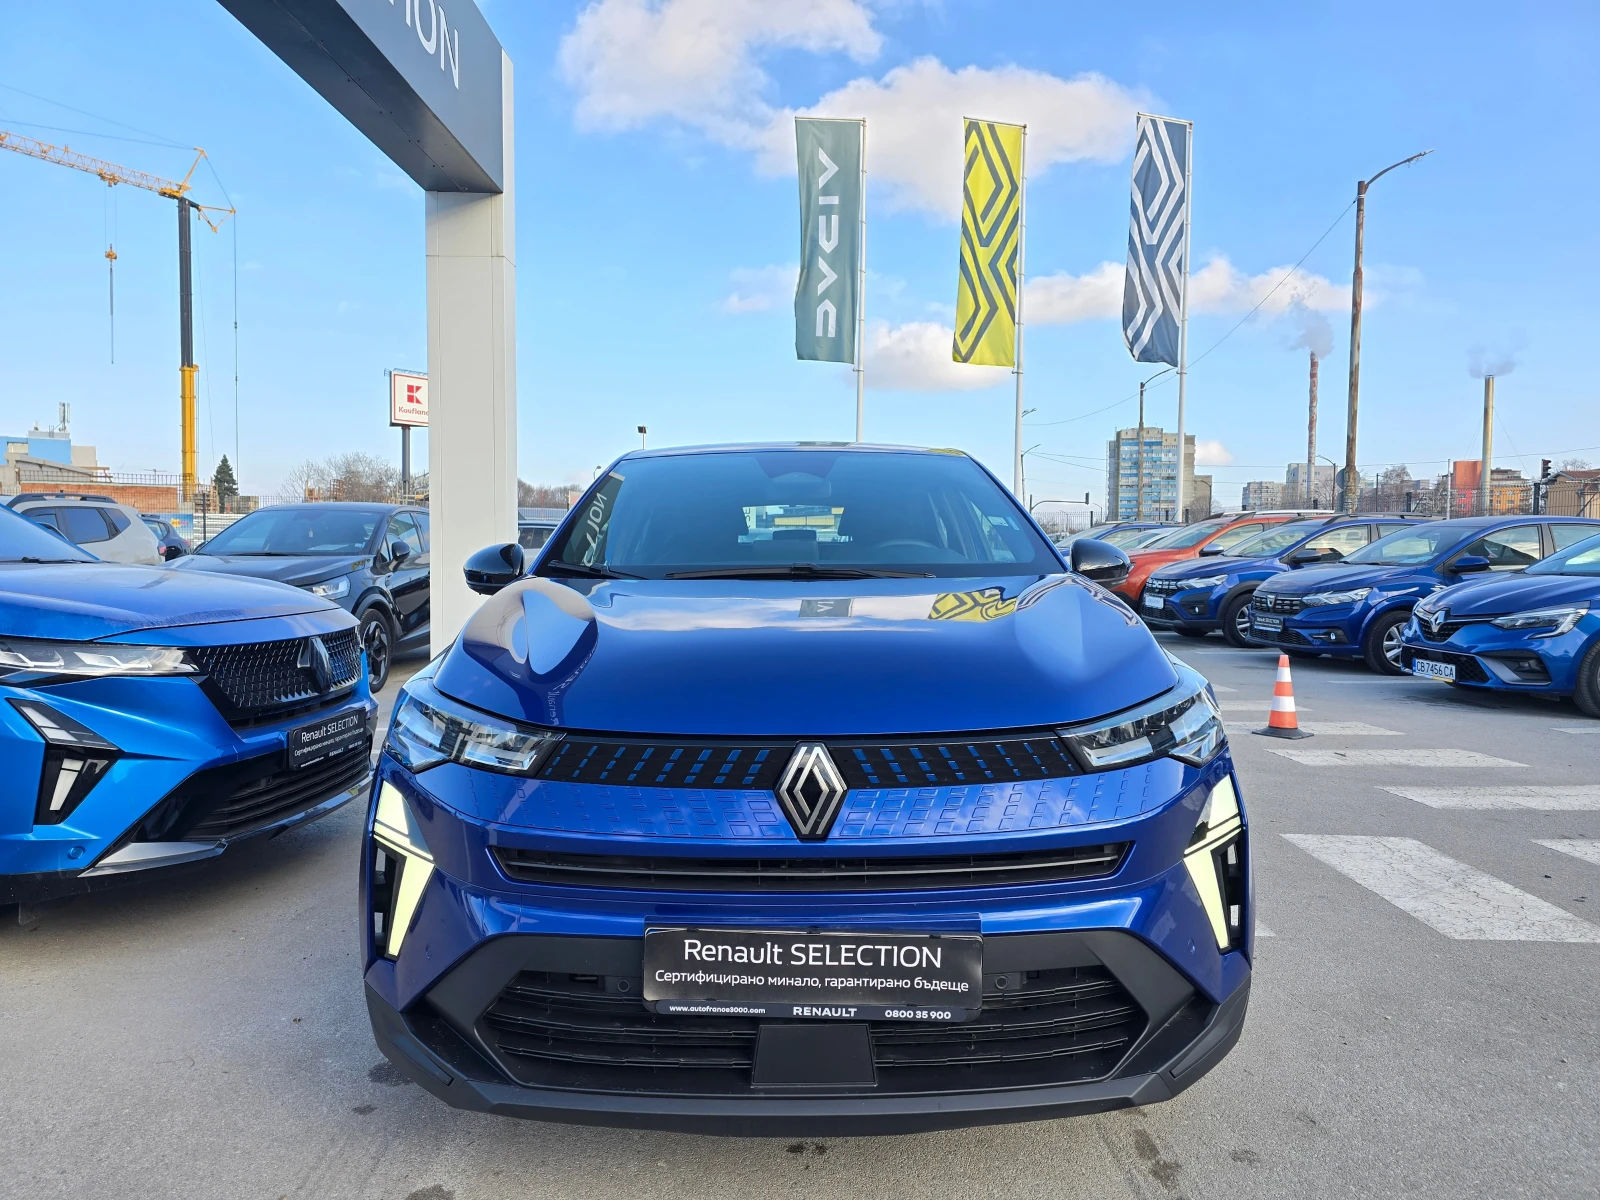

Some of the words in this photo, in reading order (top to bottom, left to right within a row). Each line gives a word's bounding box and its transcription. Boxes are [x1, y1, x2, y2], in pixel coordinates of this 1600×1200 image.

[1426, 662, 1443, 675] 7456
[301, 726, 325, 743] Renault
[327, 714, 359, 735] SELECTION
[684, 939, 783, 964] Renault
[790, 942, 942, 969] SELECTION
[655, 969, 765, 986] Сертифицирано
[767, 976, 822, 989] минало,
[824, 976, 911, 991] гарантирано
[913, 976, 970, 993] бъдеще
[792, 1006, 858, 1018] RENAULT
[884, 1008, 915, 1019] 0800
[914, 1009, 929, 1019] 35
[929, 1010, 952, 1021] 900
